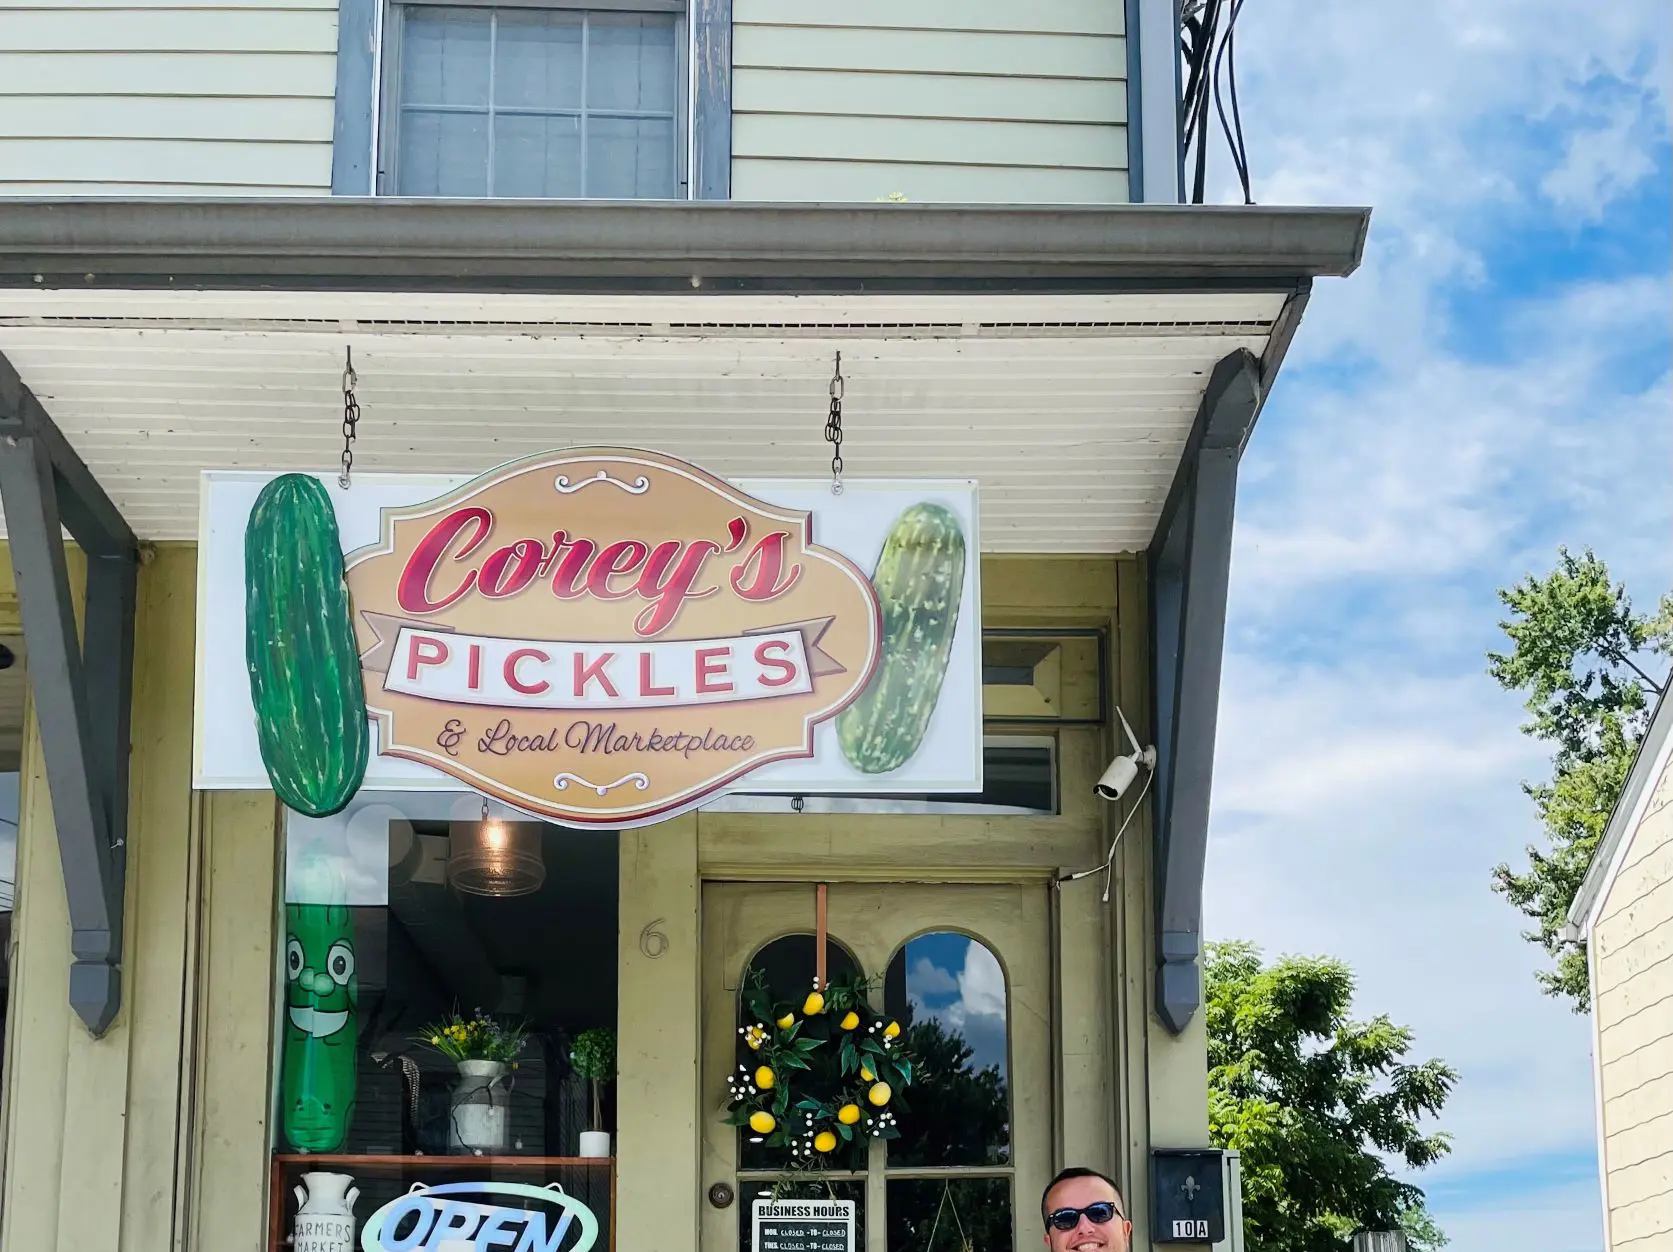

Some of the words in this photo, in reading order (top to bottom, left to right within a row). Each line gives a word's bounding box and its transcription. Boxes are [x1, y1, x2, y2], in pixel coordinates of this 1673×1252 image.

[396, 505, 801, 636] Corey's
[405, 635, 799, 698] PICKLES
[436, 718, 464, 752] &
[477, 719, 558, 753] Local
[565, 720, 755, 759] Marketplace
[640, 917, 669, 960] 6
[758, 1206, 810, 1216] BUSINESS
[813, 1206, 849, 1217] HOURS
[1175, 1221, 1206, 1236] 10A
